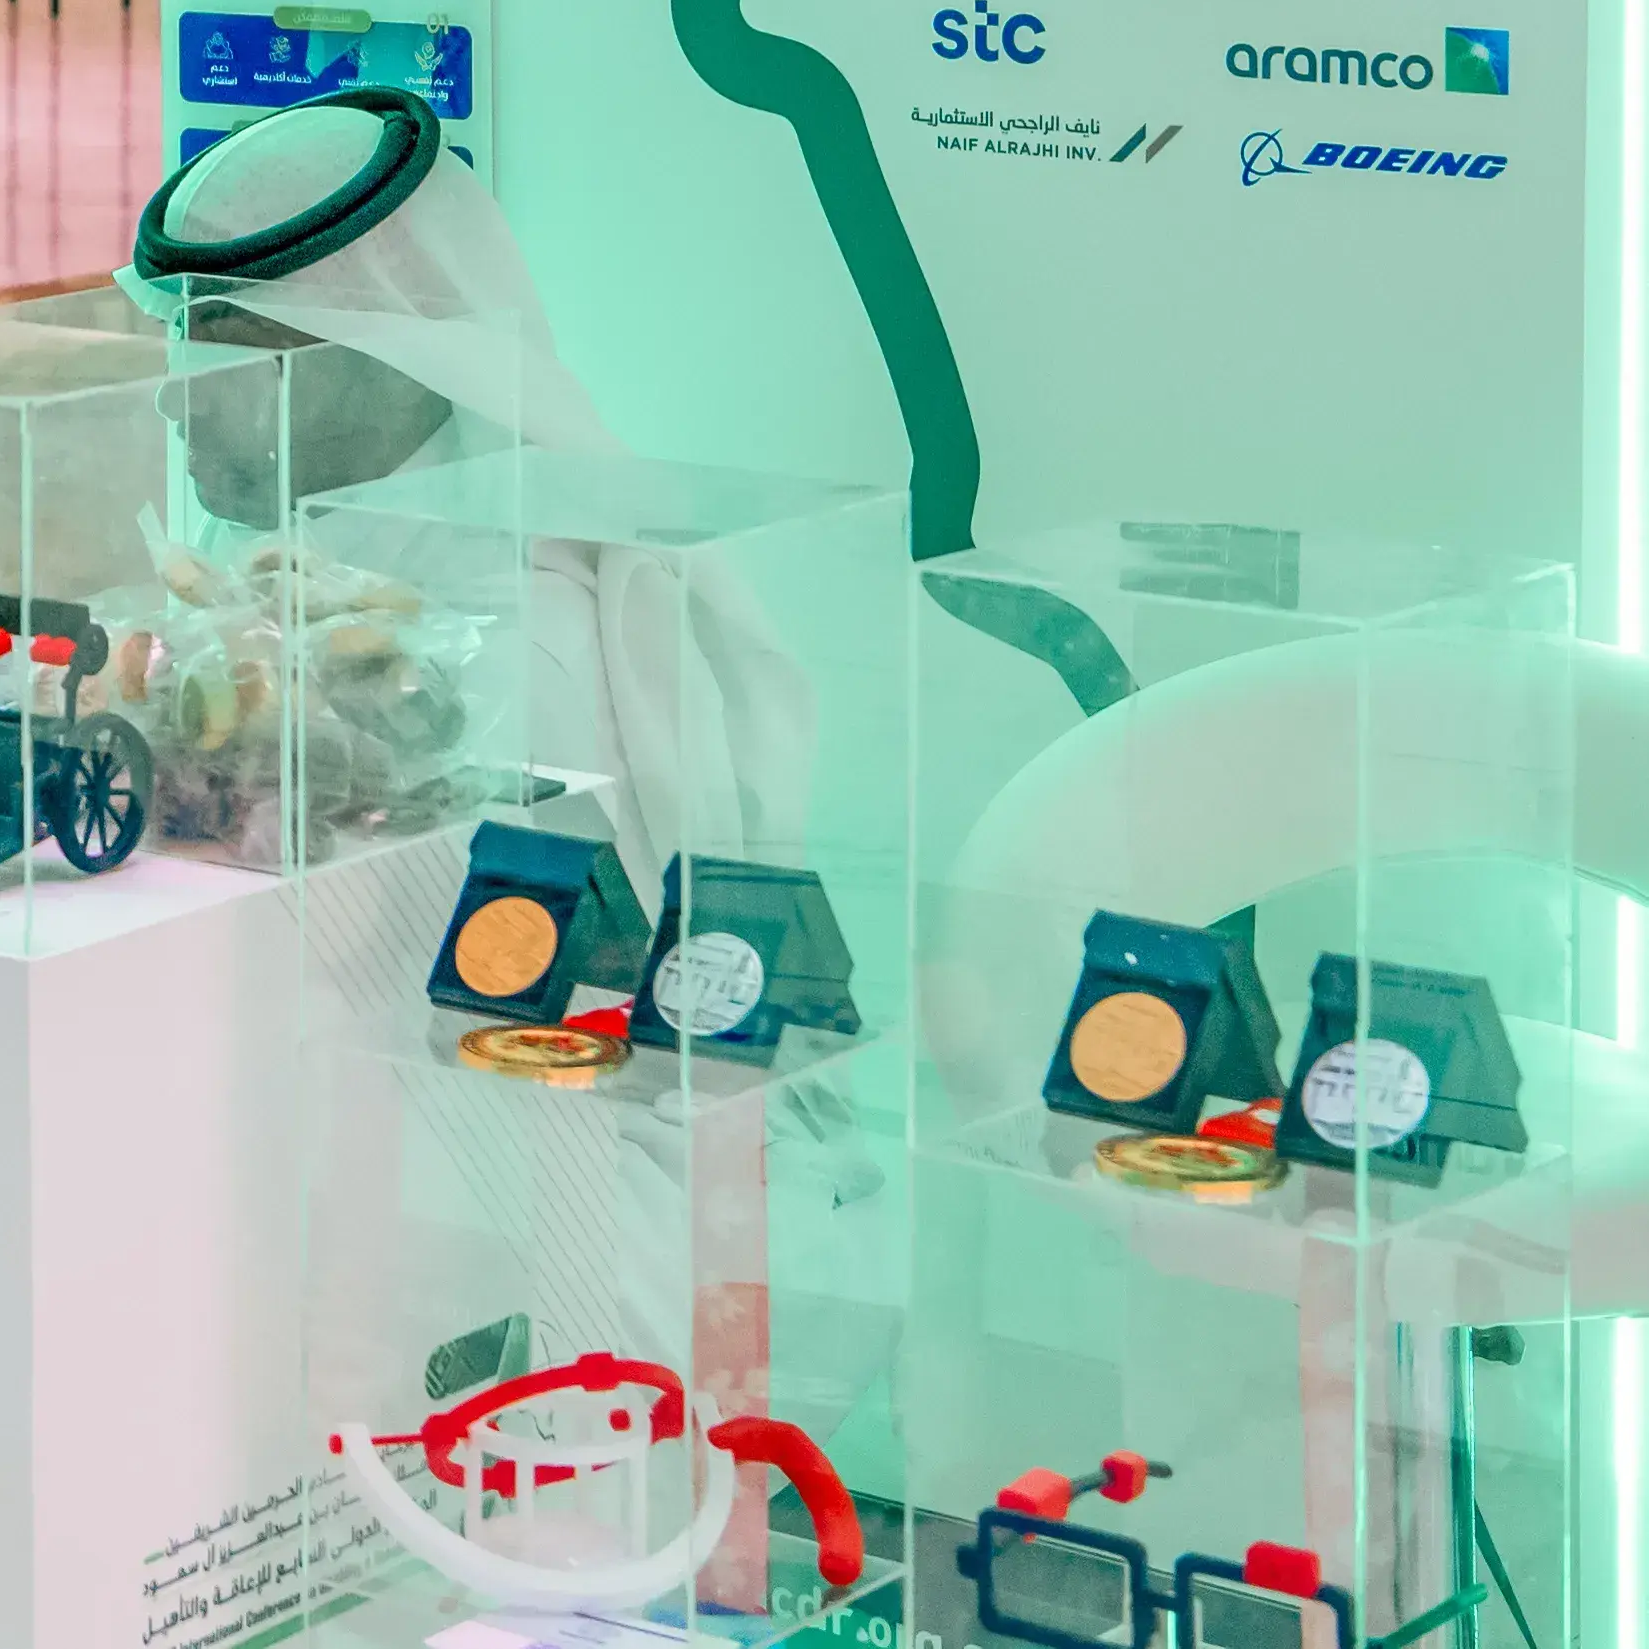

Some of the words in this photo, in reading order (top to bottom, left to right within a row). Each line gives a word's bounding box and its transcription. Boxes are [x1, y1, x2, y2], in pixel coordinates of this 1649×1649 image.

[1225, 42, 1435, 91] aramco
[910, 105, 995, 132] الاستثمارية
[999, 114, 1061, 138] الراجحي
[1065, 112, 1102, 137] نايف
[936, 135, 980, 153] NAIF
[984, 137, 1062, 159] ALRAJHI
[1066, 143, 1102, 163] INV.
[1302, 142, 1510, 181] BOEING
[143, 1560, 199, 1597] سعود
[212, 1561, 271, 1606] للإعاقة
[245, 1592, 301, 1628] Conference
